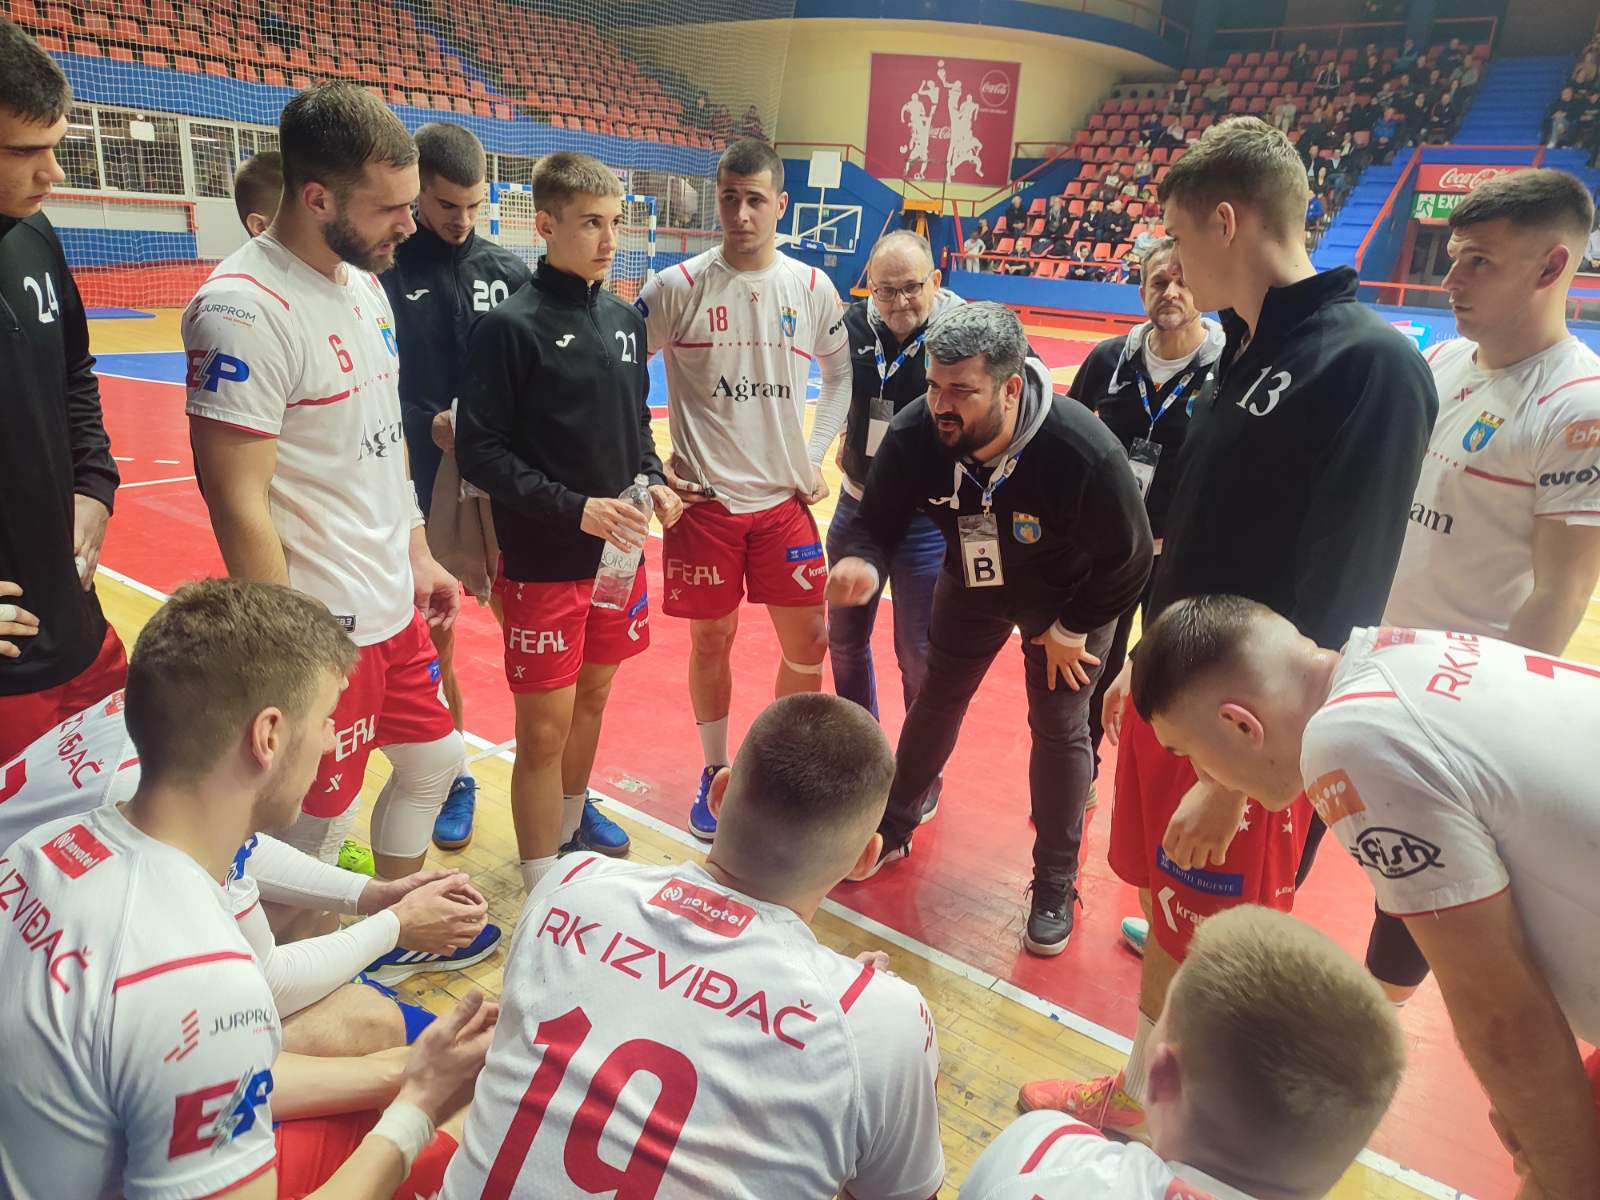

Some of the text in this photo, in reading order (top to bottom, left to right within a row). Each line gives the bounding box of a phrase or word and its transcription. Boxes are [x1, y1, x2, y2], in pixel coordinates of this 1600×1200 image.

[23, 272, 60, 323] 24
[472, 279, 509, 312] 20
[706, 305, 729, 333] 18
[328, 334, 354, 374] 6
[615, 330, 639, 364] 21
[1235, 366, 1292, 416] 13
[666, 558, 727, 587] FEAL
[973, 557, 996, 583] B
[509, 626, 569, 655] FEAL
[683, 896, 748, 928] novotel
[536, 906, 817, 1051] RK IZVIĐAČ
[479, 1005, 699, 1200] 19
